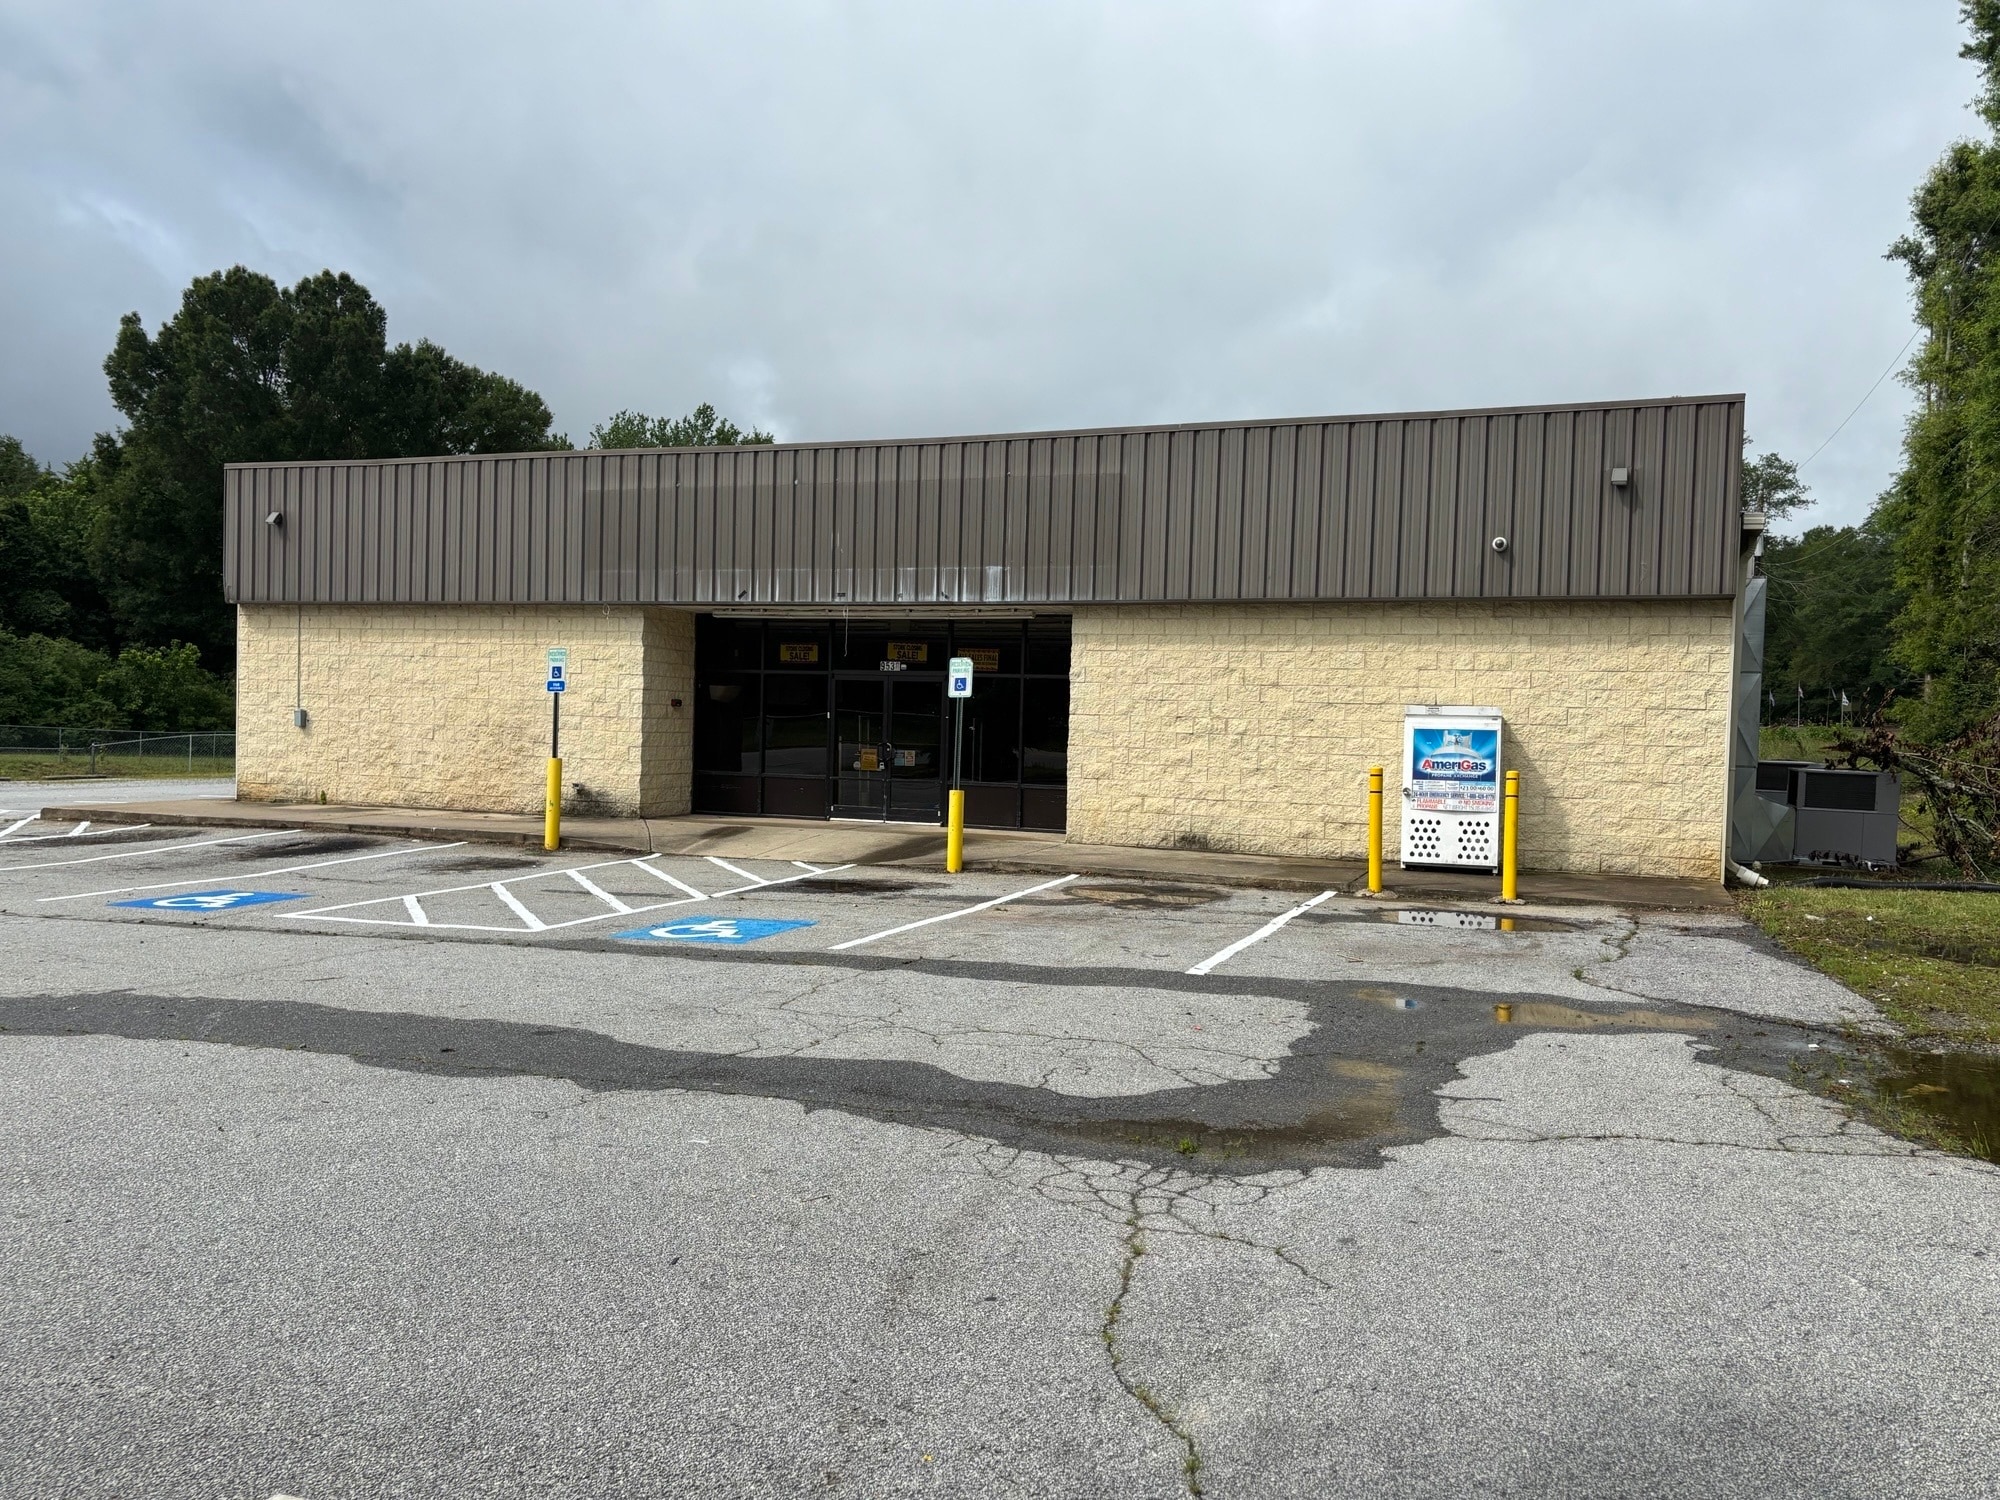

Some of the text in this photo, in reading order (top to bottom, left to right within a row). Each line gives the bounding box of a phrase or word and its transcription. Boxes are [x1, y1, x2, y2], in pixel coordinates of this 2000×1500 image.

[789, 651, 810, 660] SALE!
[897, 650, 919, 659] SALE!
[1421, 759, 1486, 771] AmeriGas
